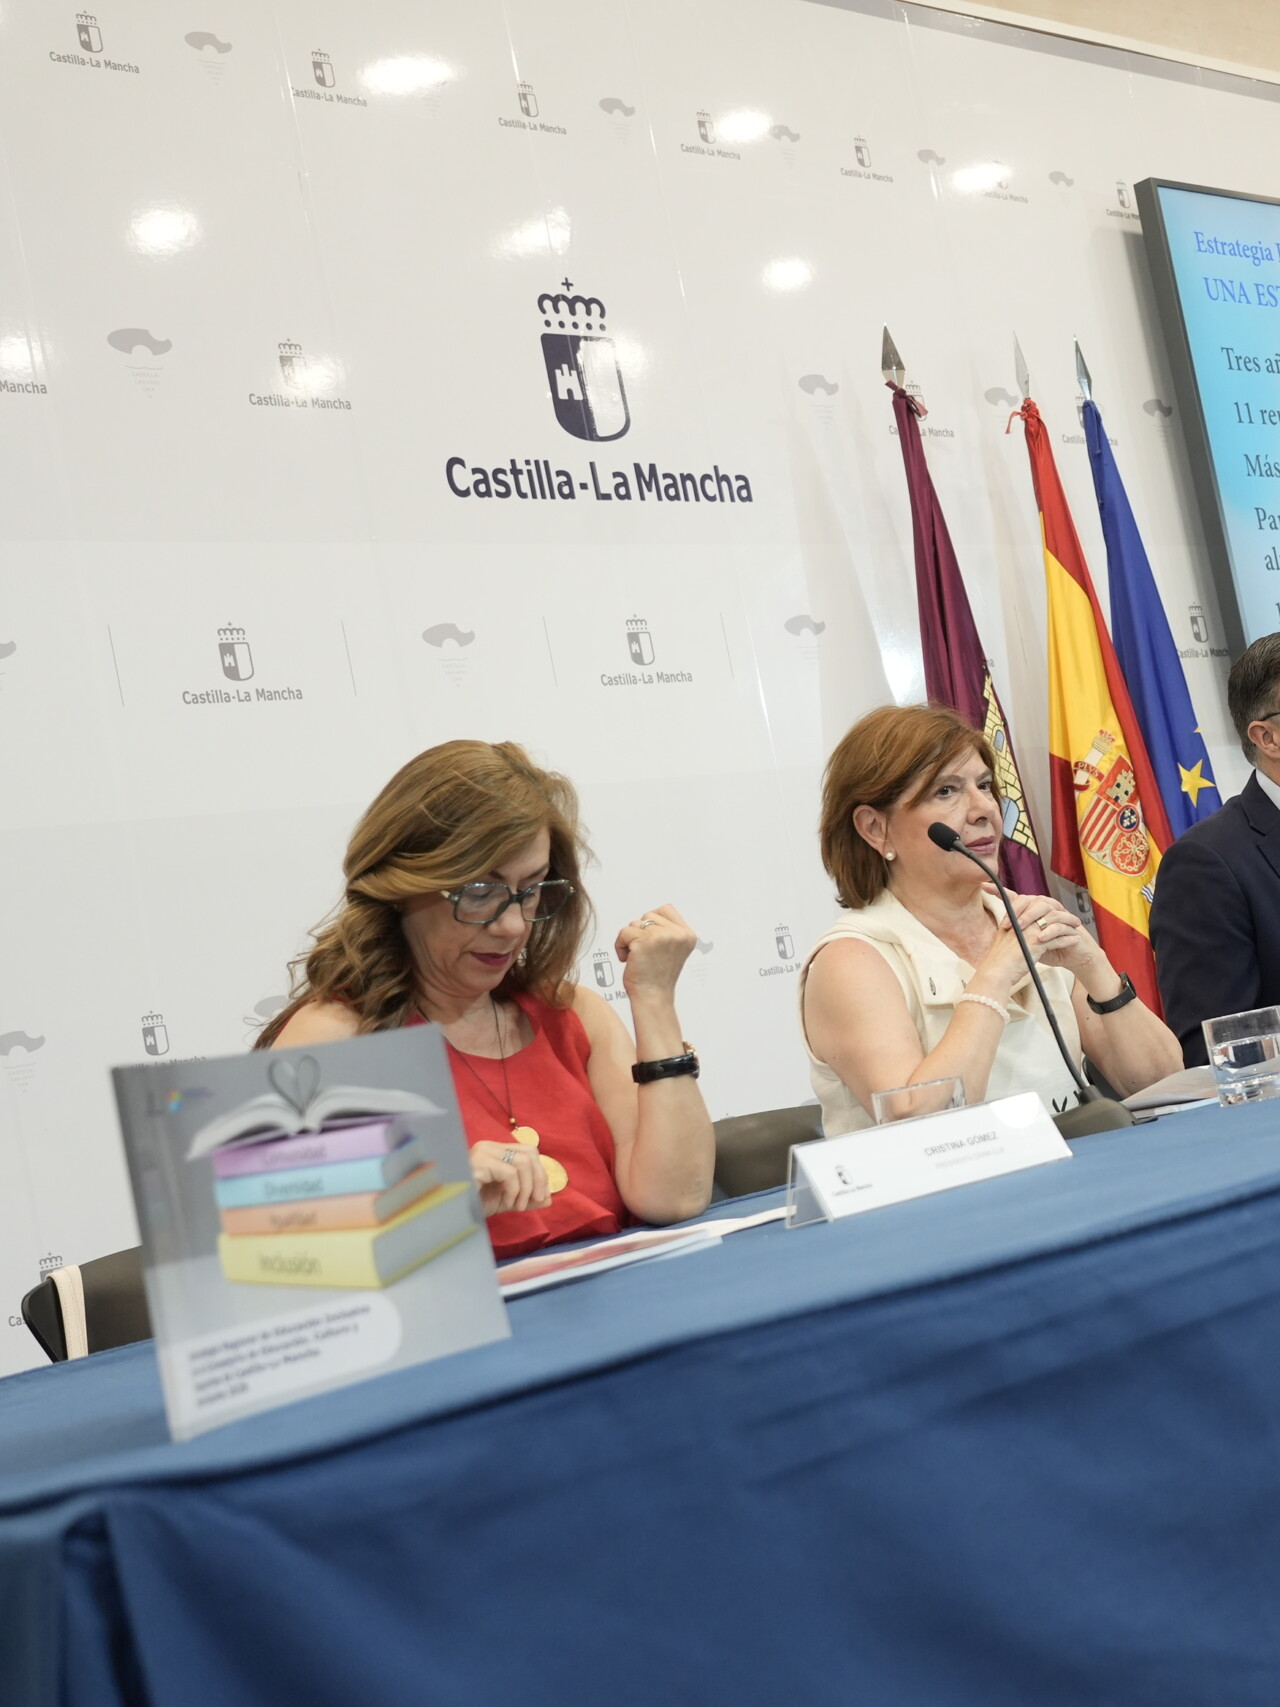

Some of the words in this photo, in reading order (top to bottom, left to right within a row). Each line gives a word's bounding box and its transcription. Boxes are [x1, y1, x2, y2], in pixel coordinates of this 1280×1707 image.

[49, 51, 101, 68] Castilla-La
[104, 59, 140, 74] Mancha
[336, 94, 368, 107] Mancha
[498, 117, 538, 131] Castilla-La
[539, 123, 567, 135] Mancha
[680, 143, 715, 157] Castilla-La
[717, 148, 741, 160] Mancha
[872, 172, 894, 183] Mancha
[1194, 231, 1274, 267] Estrategia
[1203, 277, 1251, 305] UNA
[1221, 347, 1261, 373] Tres
[311, 396, 352, 410] Mancha
[1234, 401, 1255, 425] 11
[928, 427, 955, 438] Mancha
[1062, 434, 1087, 445] Castilla
[446, 456, 632, 501] Castilla-La
[633, 462, 754, 503] Mancha
[600, 672, 654, 686] Castilla-La
[656, 671, 693, 684] Mancha
[182, 689, 251, 705] Castilla-La
[255, 687, 303, 702] Mancha
[759, 961, 794, 977] Castilla-La
[924, 1139, 966, 1156] CRISTINA
